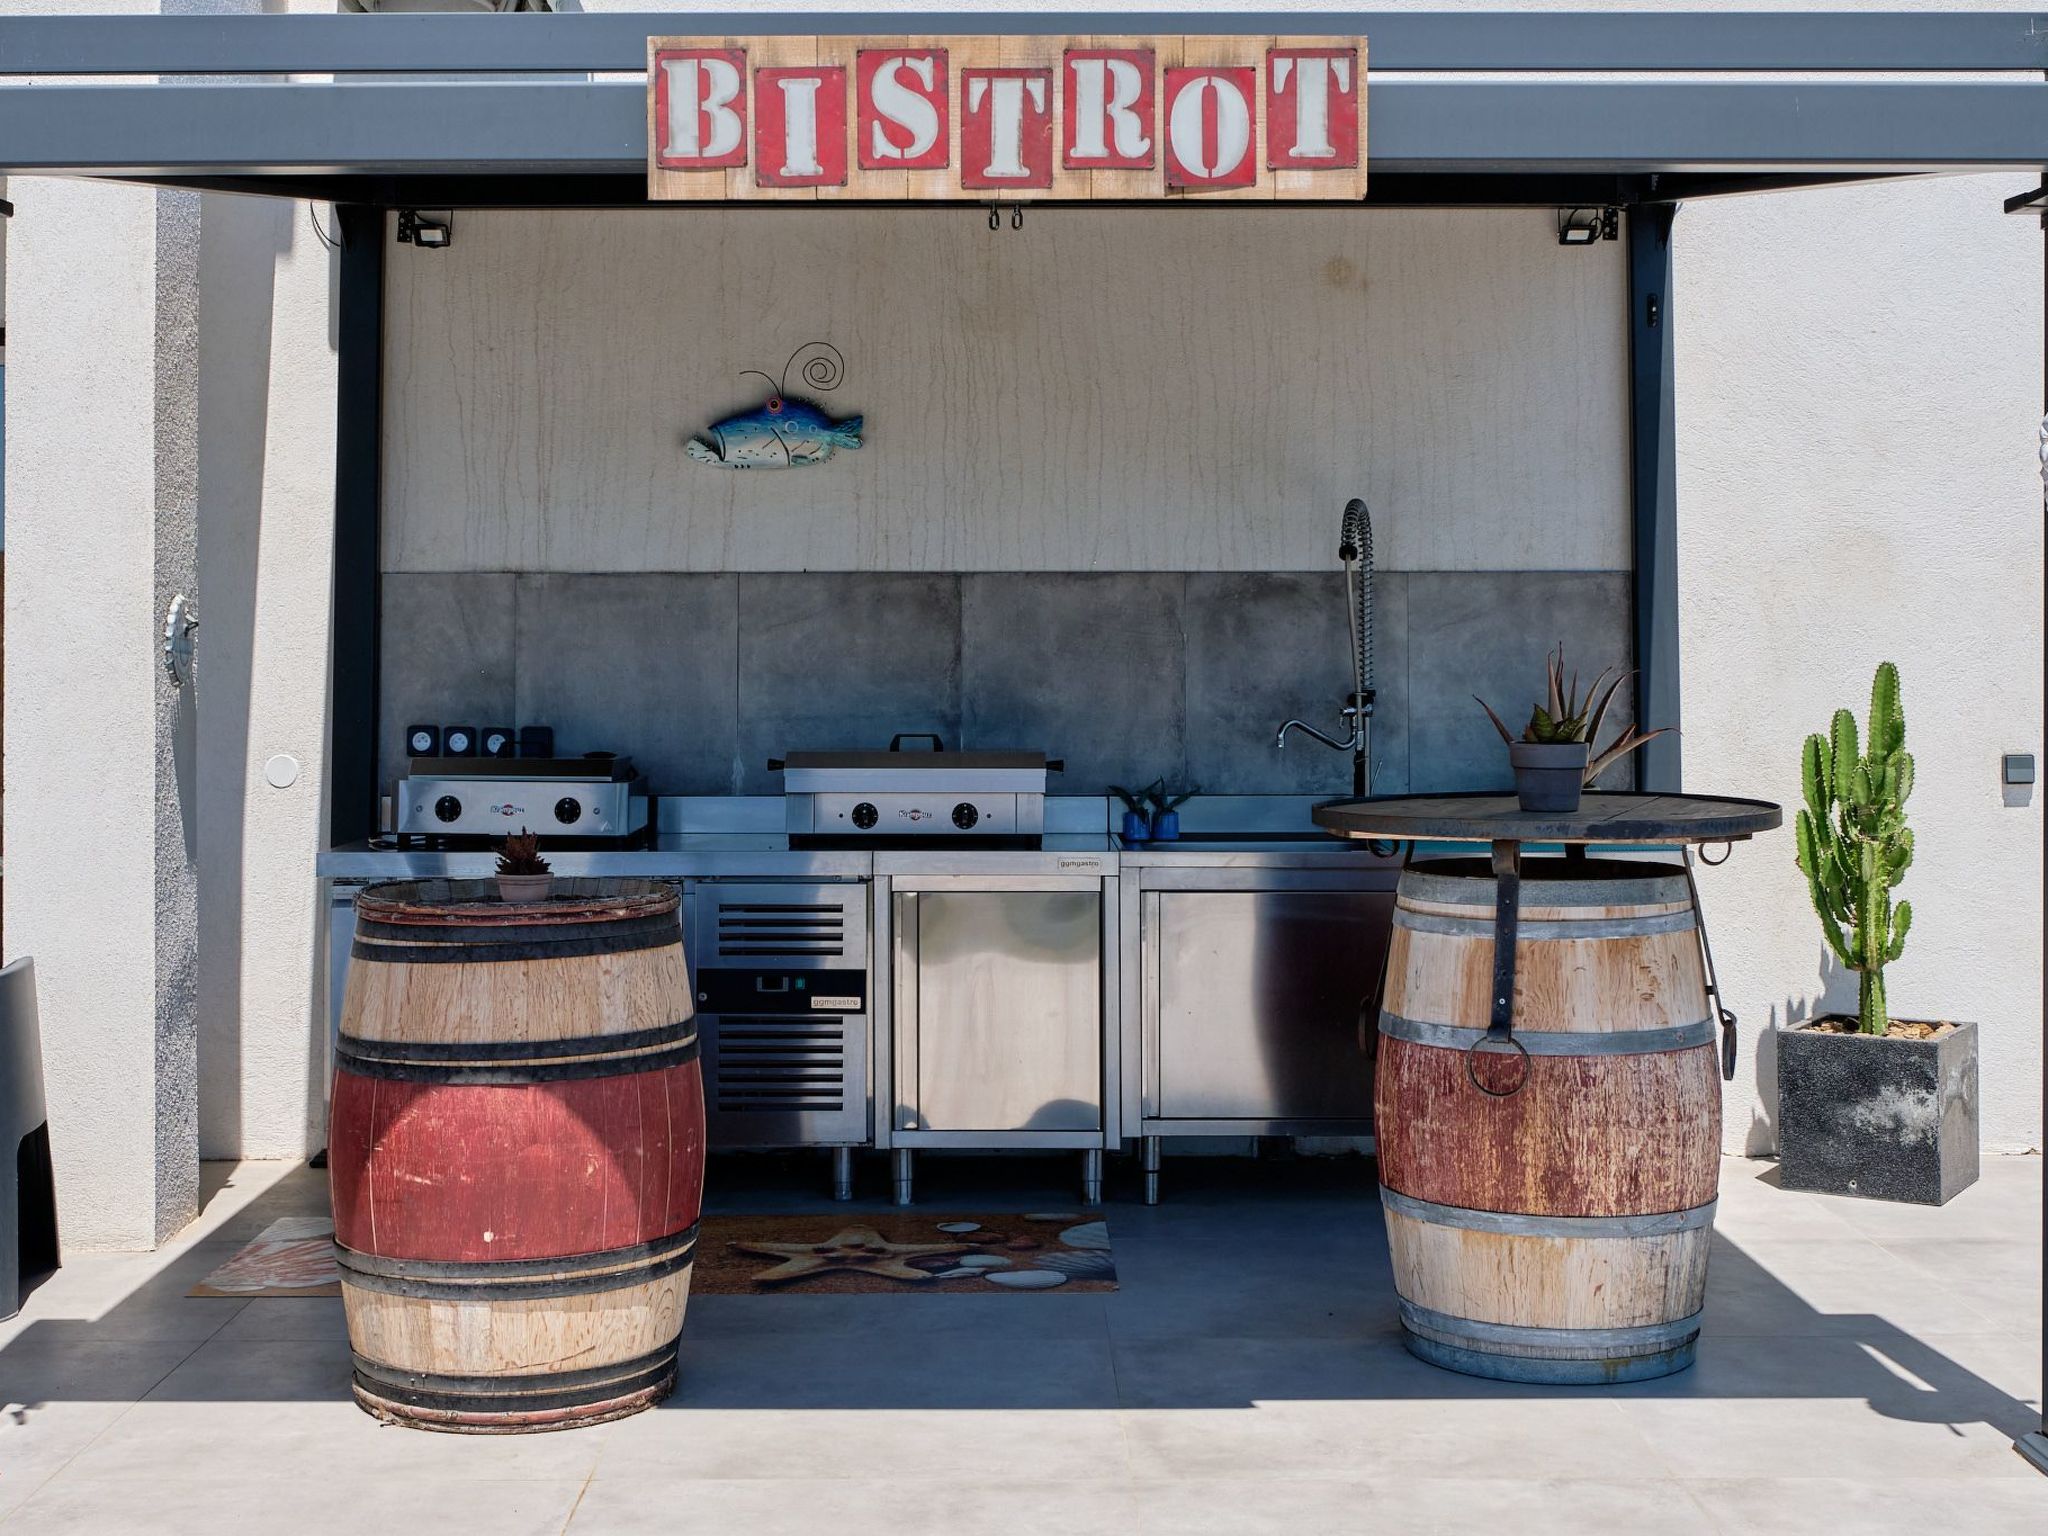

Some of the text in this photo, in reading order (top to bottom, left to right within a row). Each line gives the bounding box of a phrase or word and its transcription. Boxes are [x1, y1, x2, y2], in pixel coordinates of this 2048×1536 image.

[659, 56, 1350, 178] BISTROT
[1060, 860, 1099, 868] ggmgastro
[813, 998, 859, 1007] ggmgastro
